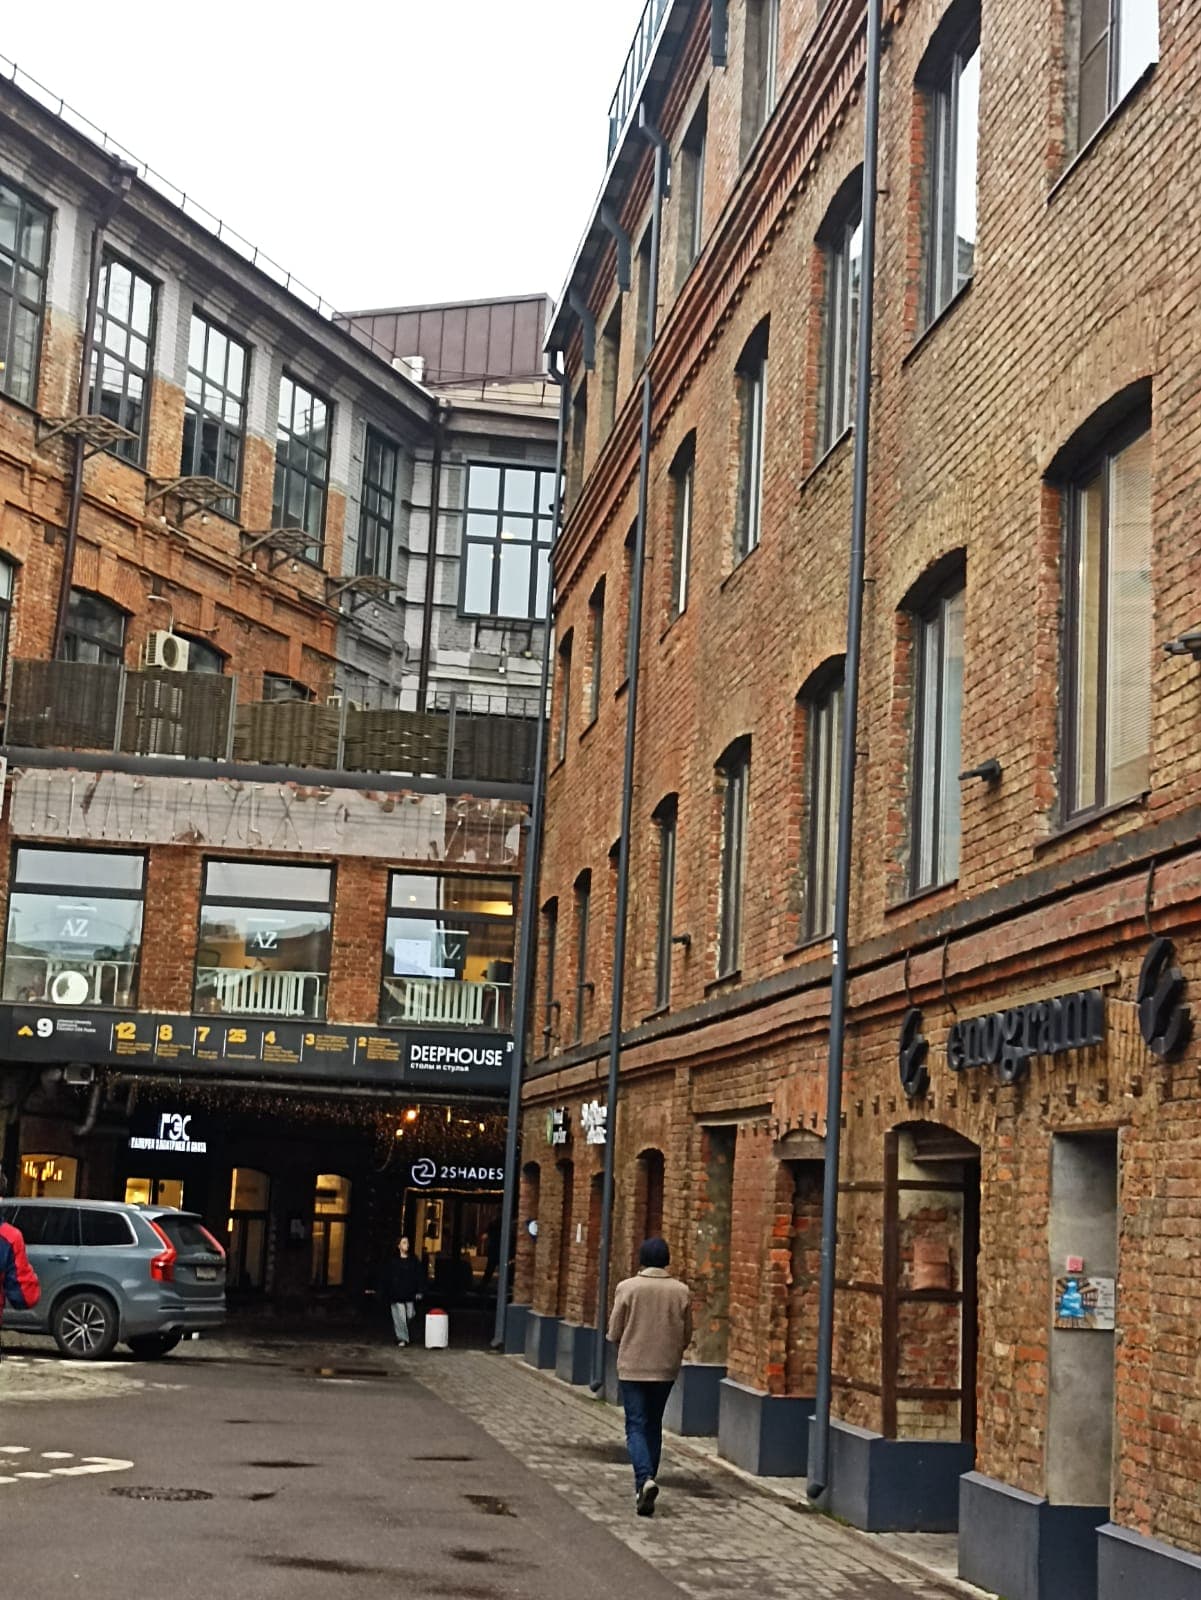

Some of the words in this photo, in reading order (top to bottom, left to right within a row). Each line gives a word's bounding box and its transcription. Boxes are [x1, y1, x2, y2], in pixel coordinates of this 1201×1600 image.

[60, 919, 88, 937] AZ
[250, 930, 278, 949] AZ
[37, 1017, 54, 1038] 9
[115, 1022, 137, 1040] 12
[159, 1024, 173, 1041] 8
[197, 1026, 211, 1042] 7
[228, 1028, 247, 1042] 25
[947, 988, 1103, 1083] enogram
[264, 1030, 276, 1044] 4
[304, 1033, 315, 1046] 3
[358, 1036, 367, 1047] 2
[410, 1044, 503, 1066] DEEPHOUSE
[442, 1064, 470, 1073] стулья
[160, 1113, 192, 1141] ГЭС
[440, 1166, 504, 1180] 2SHADES
